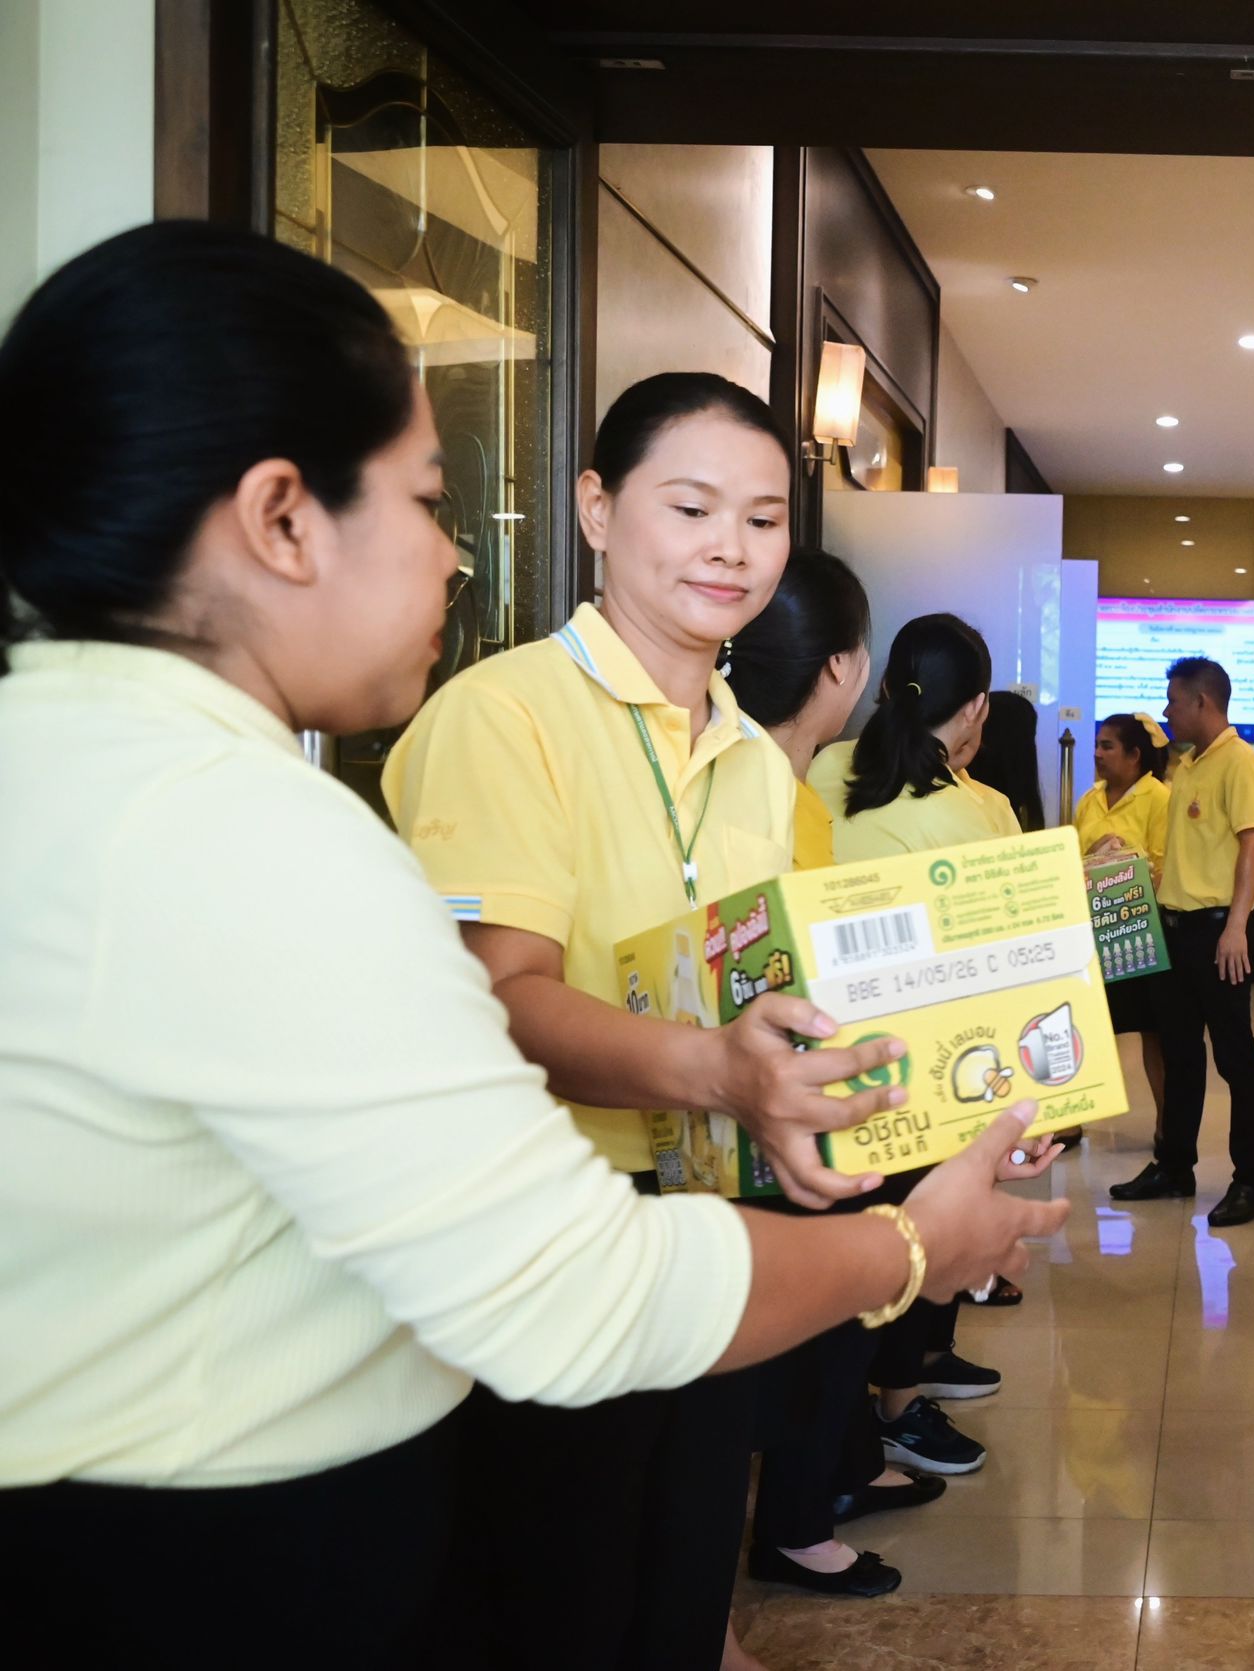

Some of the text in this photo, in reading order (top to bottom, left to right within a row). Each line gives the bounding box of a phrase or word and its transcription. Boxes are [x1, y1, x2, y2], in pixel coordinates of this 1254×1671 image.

[1092, 896, 1102, 912] 6
[1120, 905, 1130, 922] 6
[847, 942, 1056, 1004] BBE 14/05/26 C 05:25
[929, 1040, 953, 1080] ฮันนี่
[949, 1025, 997, 1049] เลมอน
